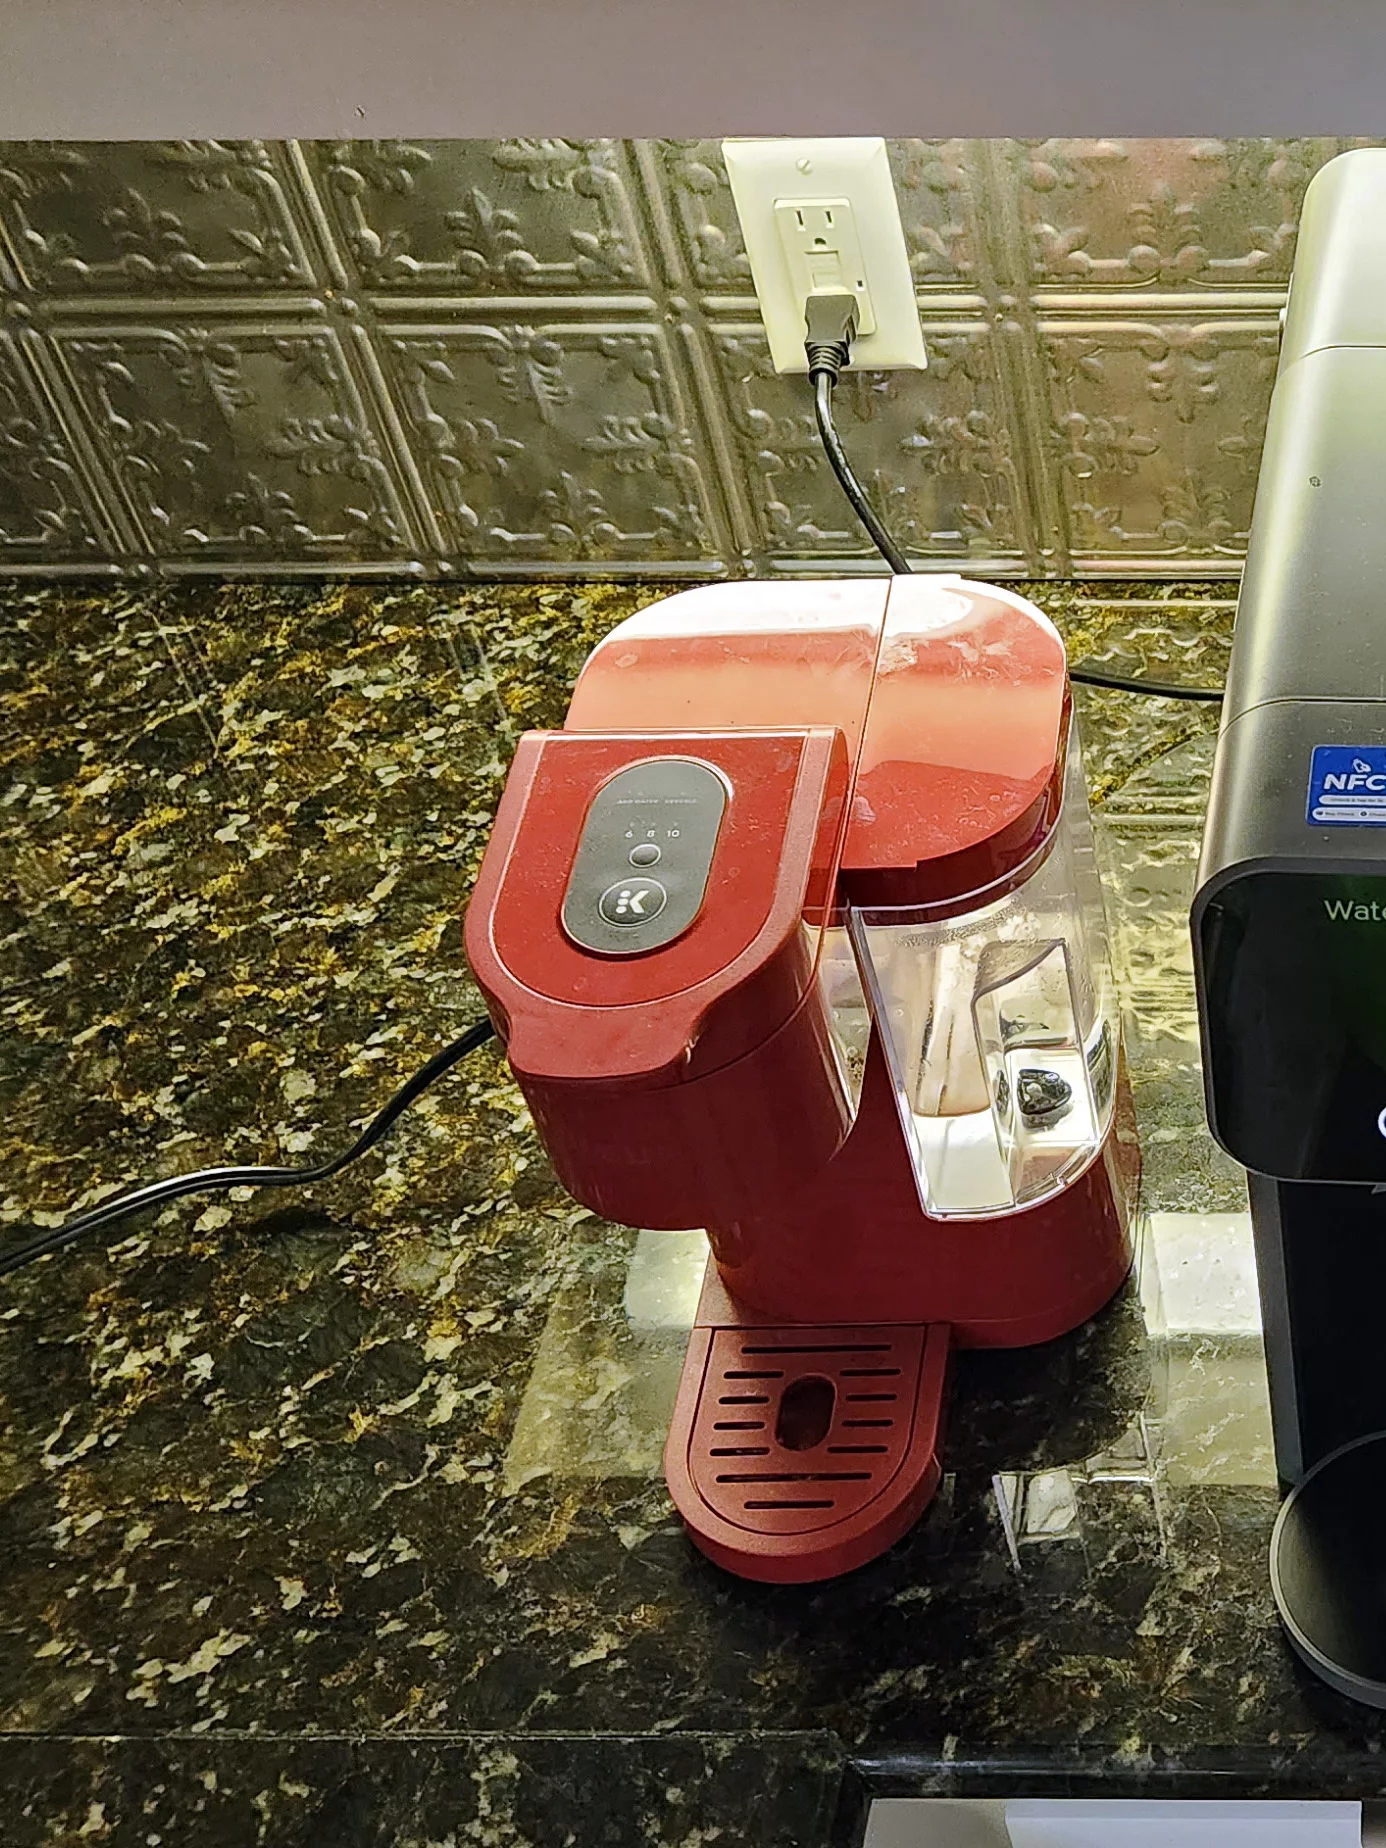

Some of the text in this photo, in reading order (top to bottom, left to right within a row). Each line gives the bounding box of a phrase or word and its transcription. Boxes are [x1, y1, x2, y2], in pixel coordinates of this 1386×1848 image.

[625, 829, 680, 838] 6 8 10
